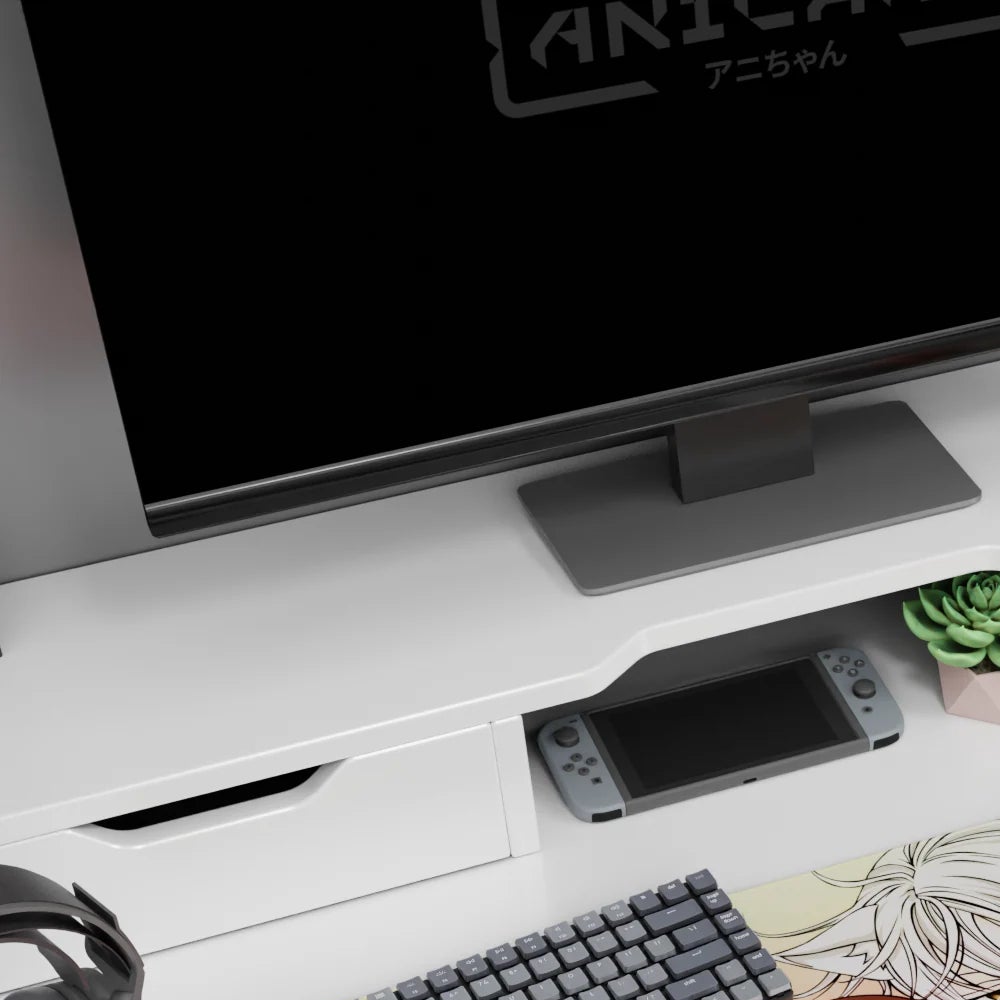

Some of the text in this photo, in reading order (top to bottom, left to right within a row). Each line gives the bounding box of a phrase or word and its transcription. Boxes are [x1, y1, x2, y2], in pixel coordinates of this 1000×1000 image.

[704, 40, 847, 91] アニちゃん
